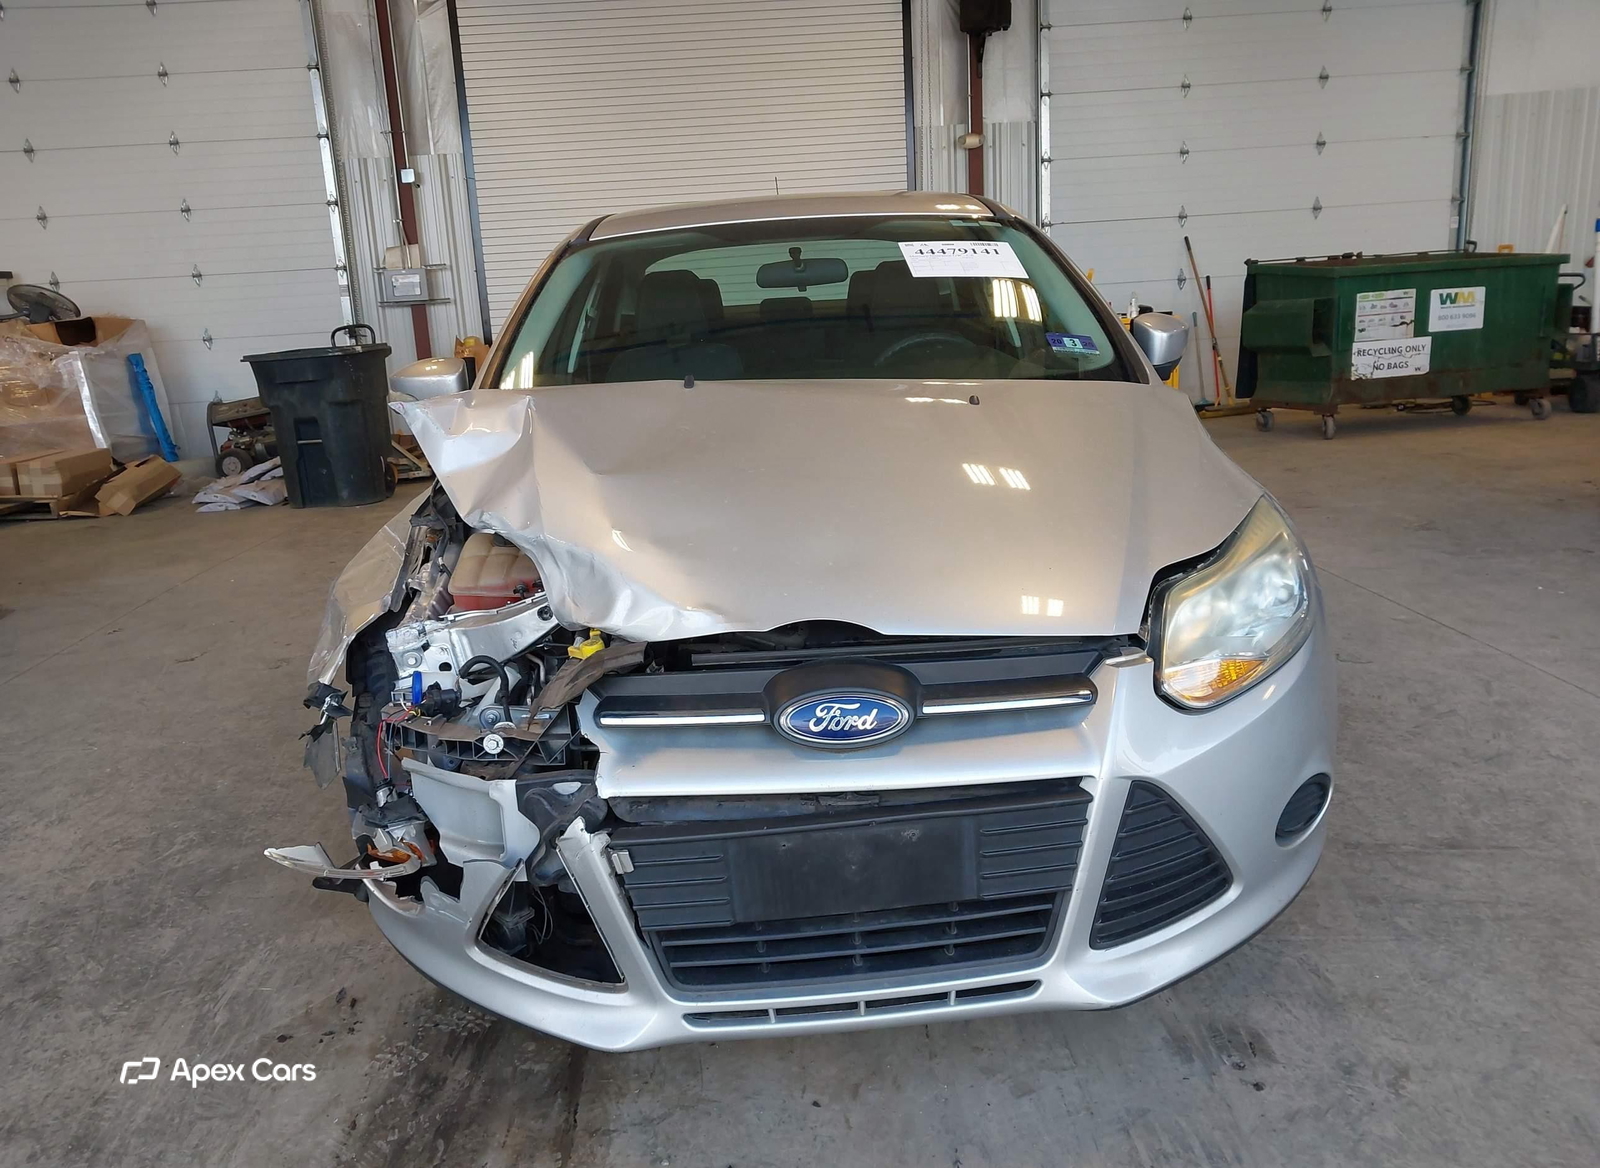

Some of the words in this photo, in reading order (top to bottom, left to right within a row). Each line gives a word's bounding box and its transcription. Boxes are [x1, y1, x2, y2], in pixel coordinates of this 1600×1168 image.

[914, 247, 1001, 256] 44479141
[1439, 291, 1476, 306] WM
[1069, 338, 1078, 347] 3
[1357, 346, 1403, 357] RECYCLING
[1405, 344, 1426, 353] ONLY
[1373, 362, 1385, 371] NO
[1387, 361, 1409, 370] BAGS
[808, 702, 878, 733] Ford
